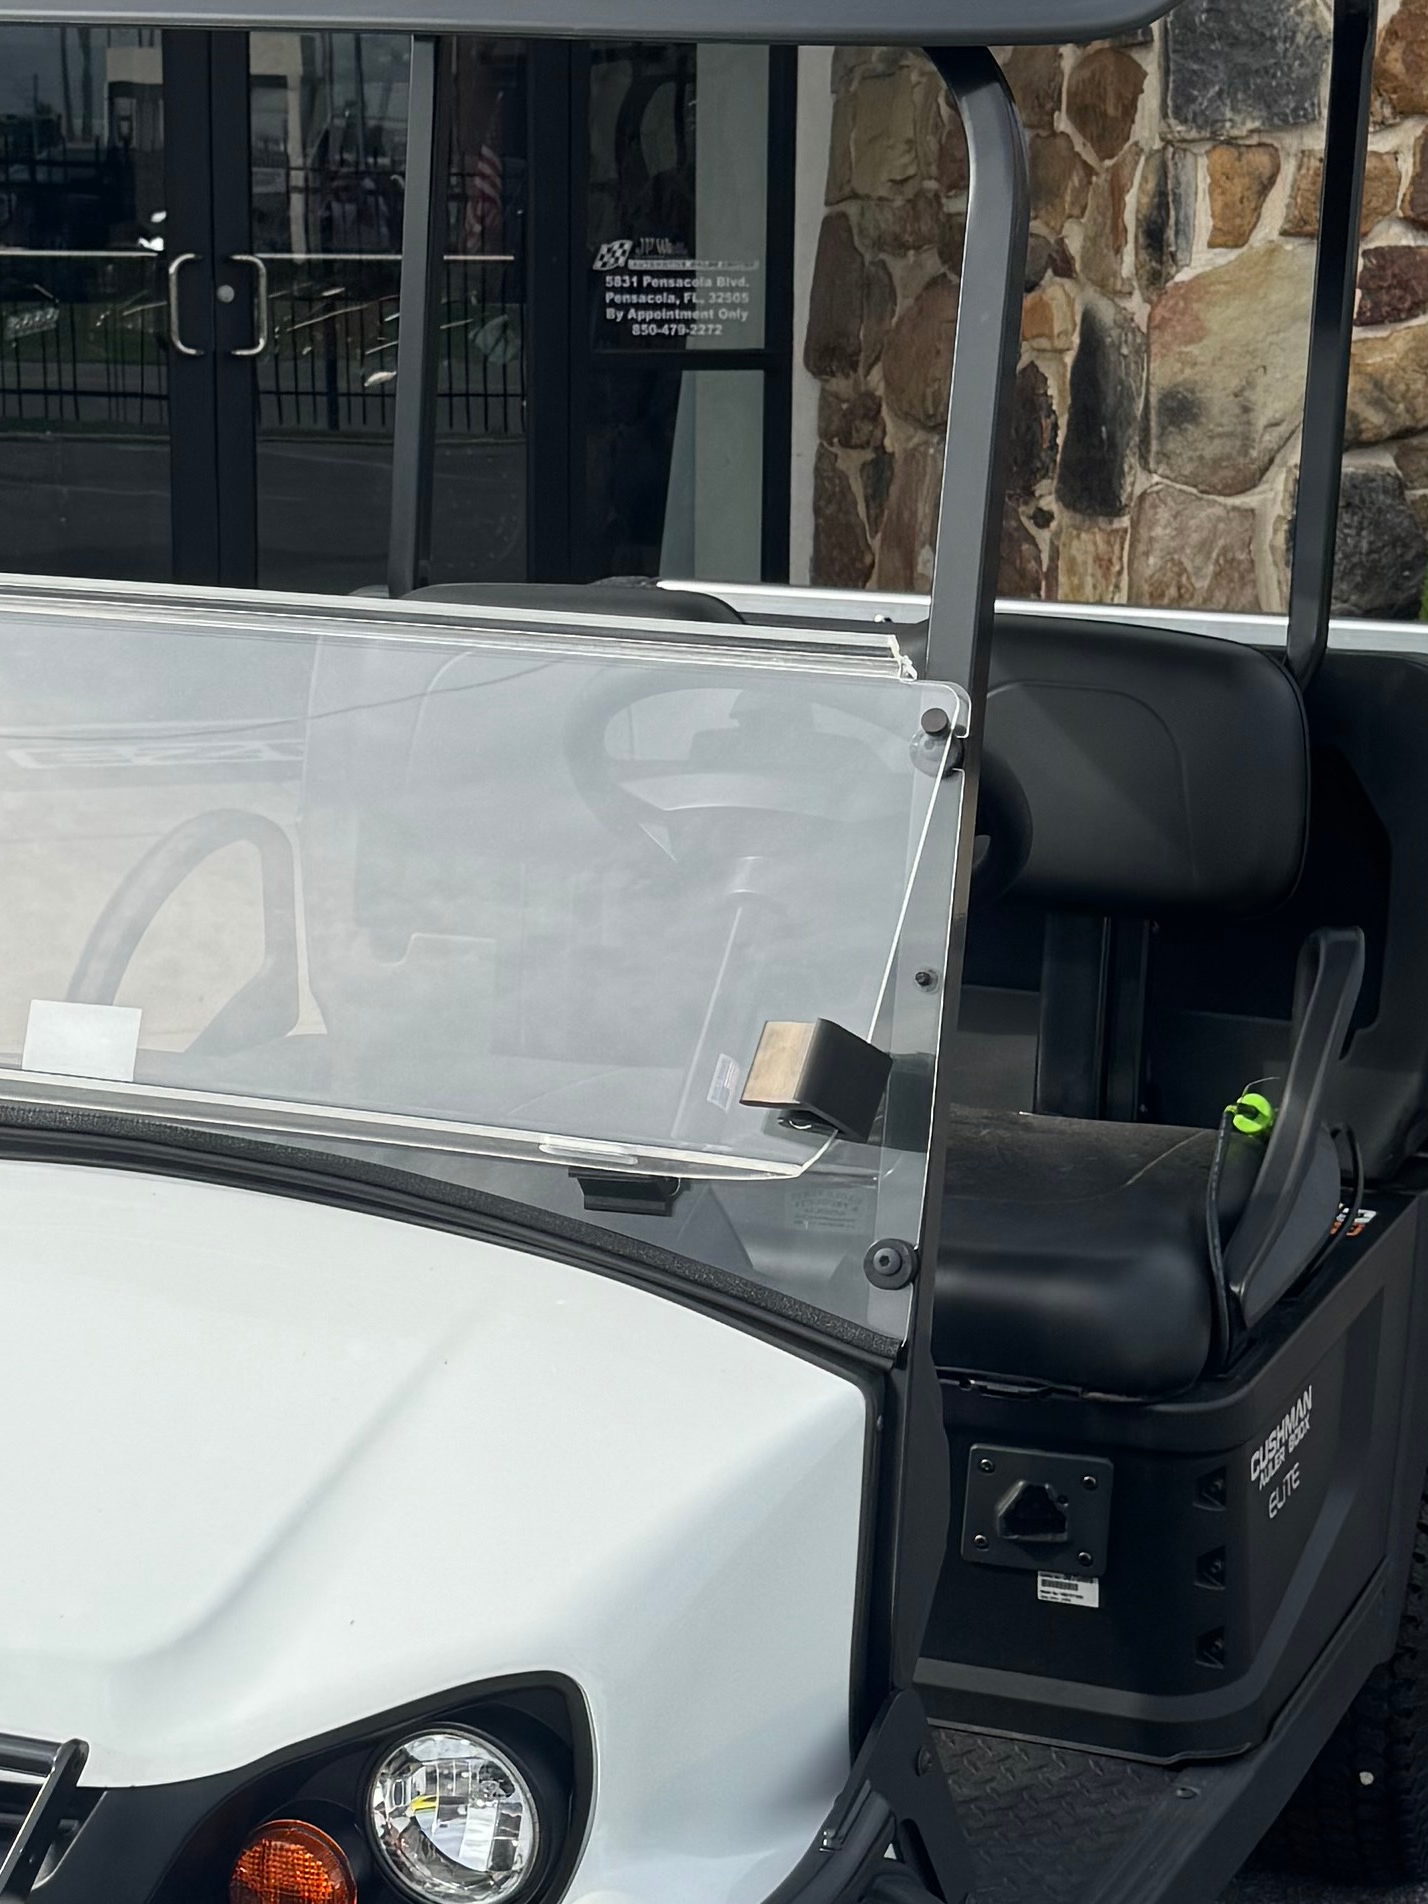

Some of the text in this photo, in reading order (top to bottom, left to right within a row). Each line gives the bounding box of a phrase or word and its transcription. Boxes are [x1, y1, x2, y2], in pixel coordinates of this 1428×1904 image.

[605, 275, 750, 288] 5831 Pensacola Blvd.
[605, 292, 681, 305] Pensacola,
[708, 292, 750, 304] 32505
[605, 308, 749, 322] By Appointment Only
[632, 323, 723, 336] 850-479-2272
[1251, 1384, 1313, 1482] CUSHMAN
[1269, 1461, 1300, 1519] ELITE
